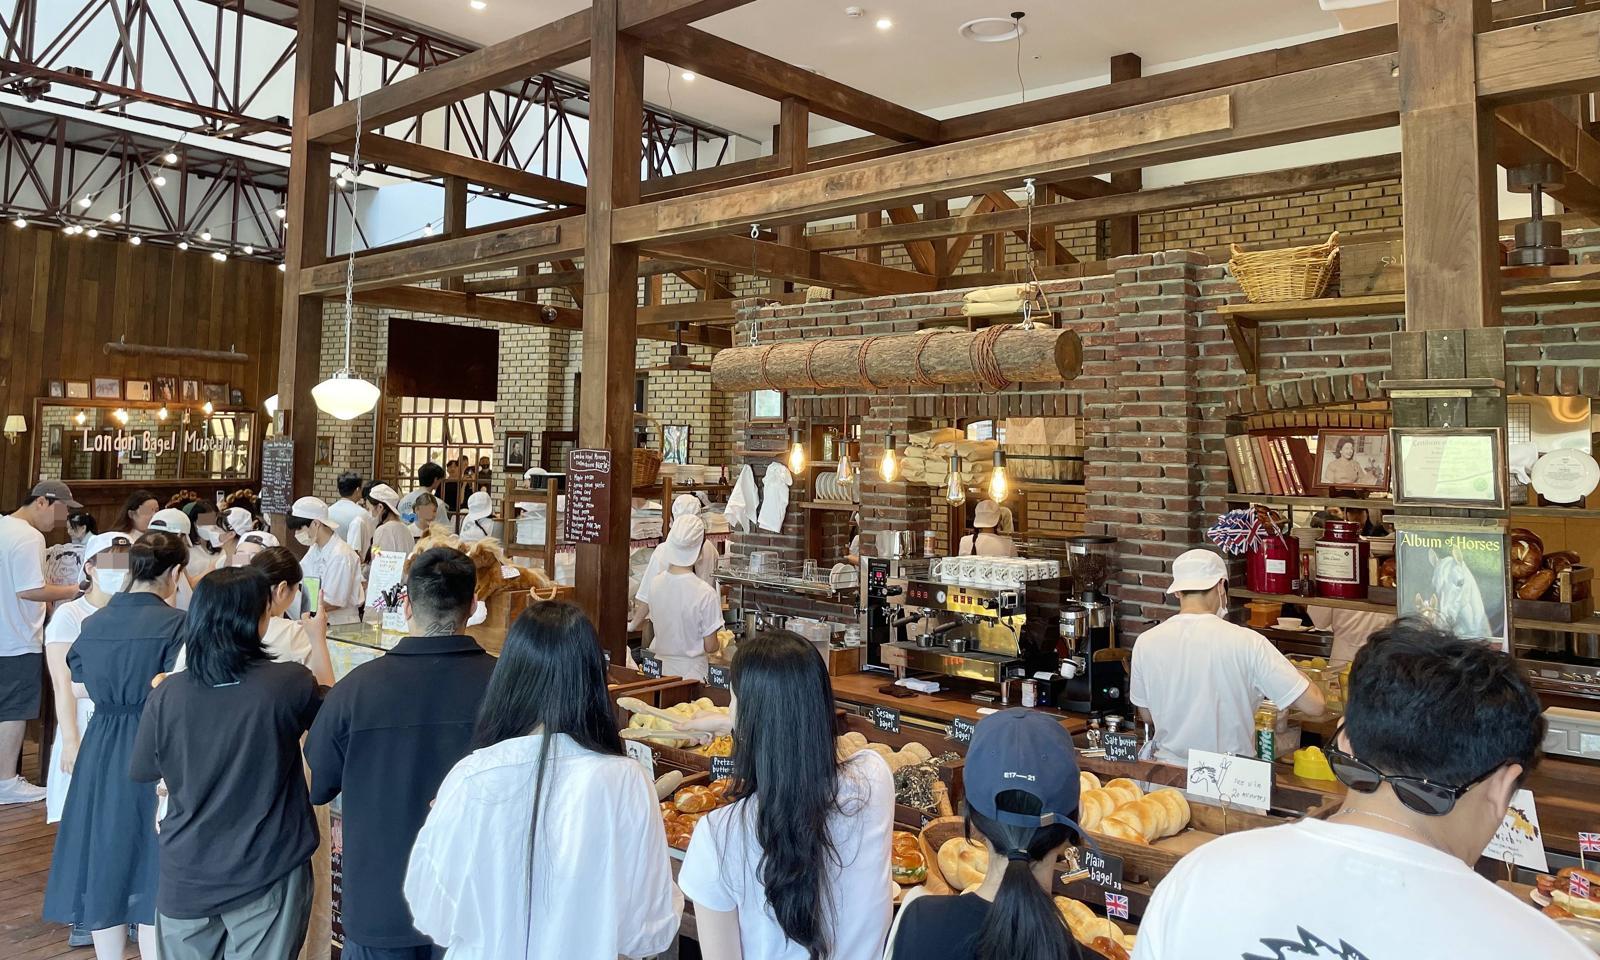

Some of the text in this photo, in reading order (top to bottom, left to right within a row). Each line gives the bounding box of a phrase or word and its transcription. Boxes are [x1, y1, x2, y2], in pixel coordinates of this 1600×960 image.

[83, 427, 235, 457] London Bagel Museum
[1401, 533, 1500, 551] Album of Horses
[876, 707, 896, 720] Sesame
[879, 718, 893, 731] bagel
[954, 731, 971, 742] bagel
[1104, 734, 1137, 747] Salt butter
[1110, 745, 1127, 757] bagel
[1258, 731, 1272, 761] prite
[1085, 851, 1105, 869] Plain
[1091, 867, 1113, 886] bagel
